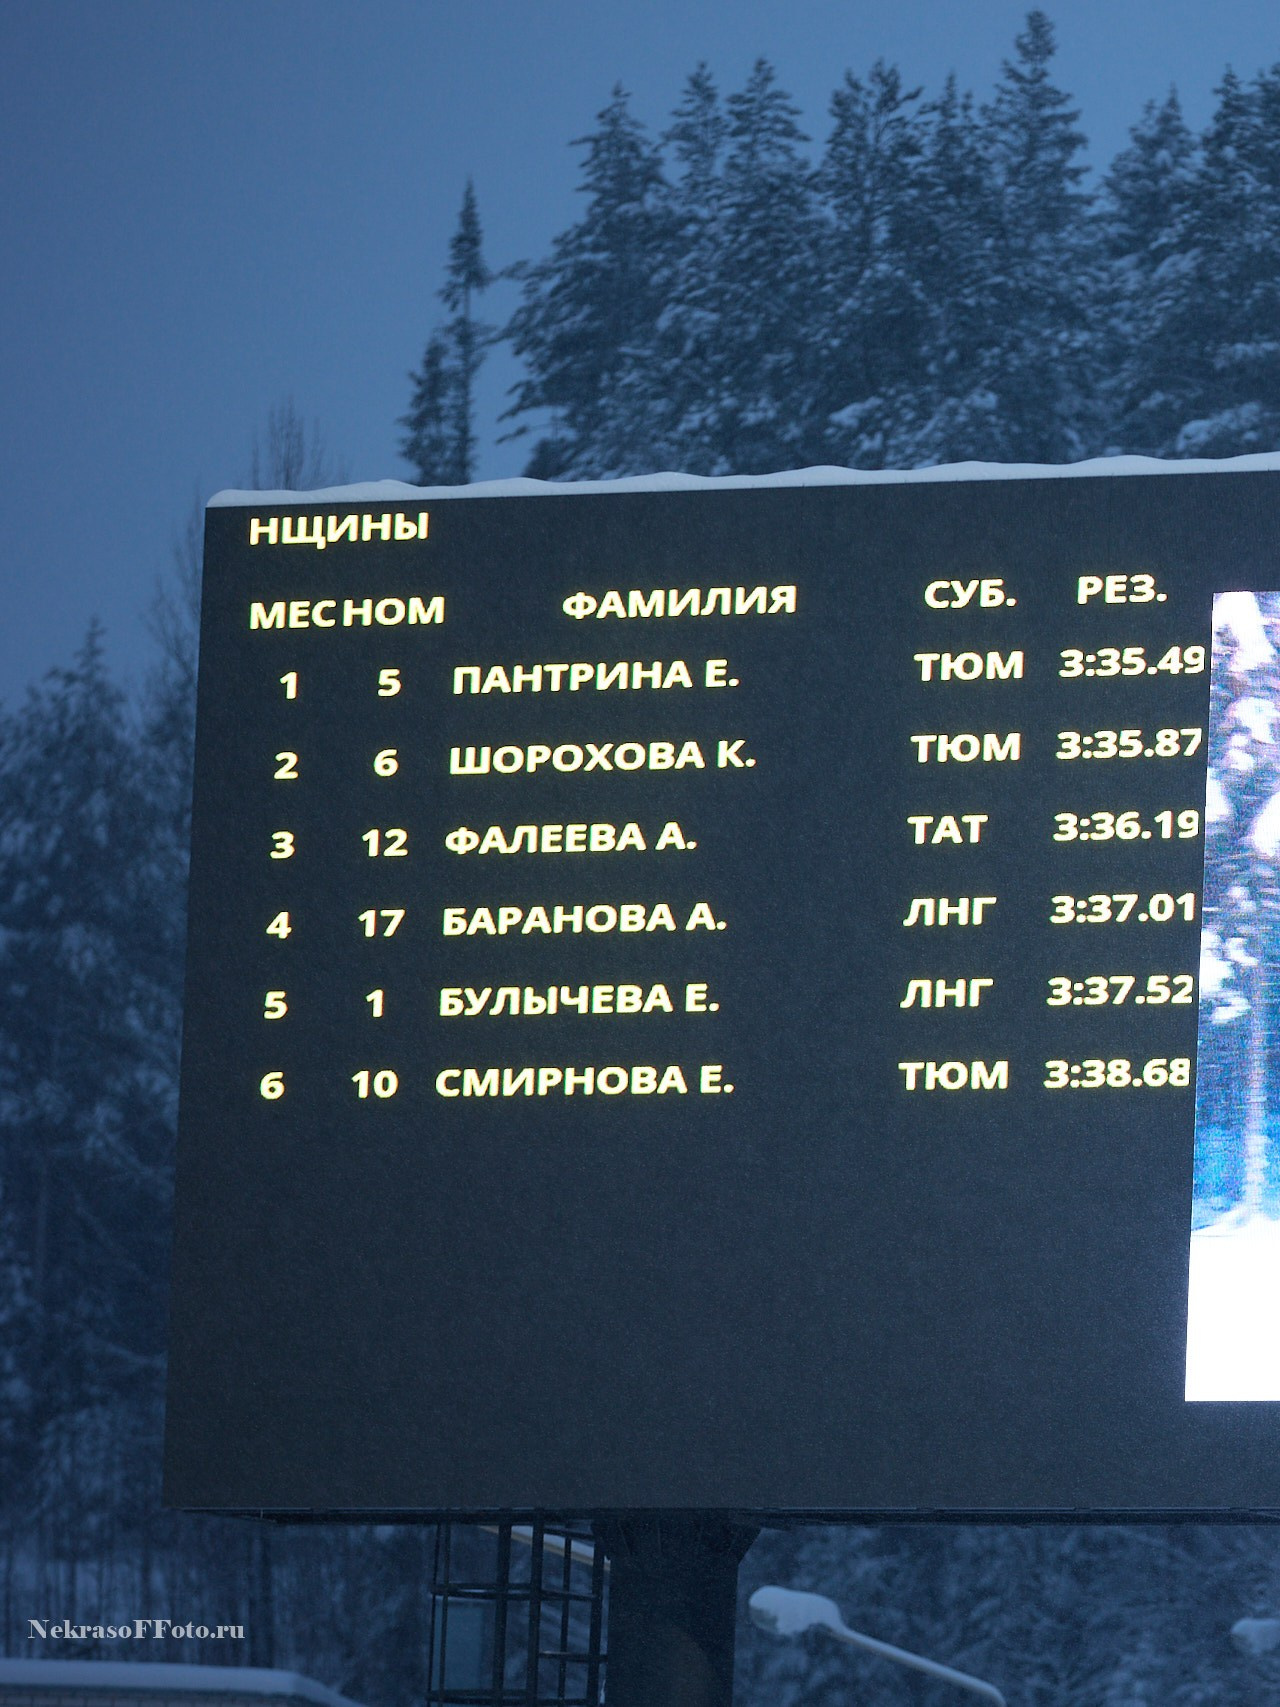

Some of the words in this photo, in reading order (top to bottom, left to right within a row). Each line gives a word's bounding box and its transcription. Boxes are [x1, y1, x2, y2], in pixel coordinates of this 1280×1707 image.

[249, 511, 429, 550] НЩИНЫ
[249, 599, 337, 630] МЕС
[342, 596, 445, 627] НОМ
[562, 585, 797, 620] ФАМИЛИЯ
[924, 578, 1017, 609] СУБ.
[1077, 573, 1168, 605] РЕЗ.
[279, 671, 297, 700] 1
[377, 668, 402, 697] 5
[453, 660, 693, 695] ПАНТРИНА
[705, 658, 740, 688] Е.
[913, 650, 1024, 682] ТЮМ
[1058, 645, 1206, 678] 3:35.49
[273, 751, 299, 780] 2
[373, 748, 398, 777] 6
[449, 740, 706, 775] ШОРОХОВА
[717, 739, 757, 768] К.
[910, 732, 1021, 764] ТЮМ
[1055, 727, 1203, 760] 3:35.87
[269, 831, 295, 859] 3
[361, 828, 408, 857] 12
[445, 822, 647, 855] ФАЛЕЕВА
[654, 821, 698, 851] А.
[906, 814, 989, 845] ТАТ
[1052, 809, 1200, 842] 3:36.19
[265, 911, 292, 939] 4
[357, 909, 405, 938] 17
[442, 903, 677, 936] БАРАНОВА
[685, 902, 727, 931] А.
[902, 896, 998, 927] ЛНГ
[1049, 892, 1195, 924] 3:37.01
[263, 990, 288, 1020] 5
[365, 989, 384, 1018] 1
[439, 984, 674, 1017] БУЛЫЧЕВА
[685, 983, 720, 1013] Е.
[899, 978, 994, 1009] ЛНГ
[1046, 974, 1194, 1006] 3:37.52
[260, 1071, 284, 1100] 6
[351, 1069, 398, 1099] 10
[435, 1065, 688, 1097] СМИРНОВА
[700, 1064, 735, 1094] Е.
[897, 1060, 1009, 1091] ТЮМ
[1043, 1057, 1191, 1089] 3:38.68
